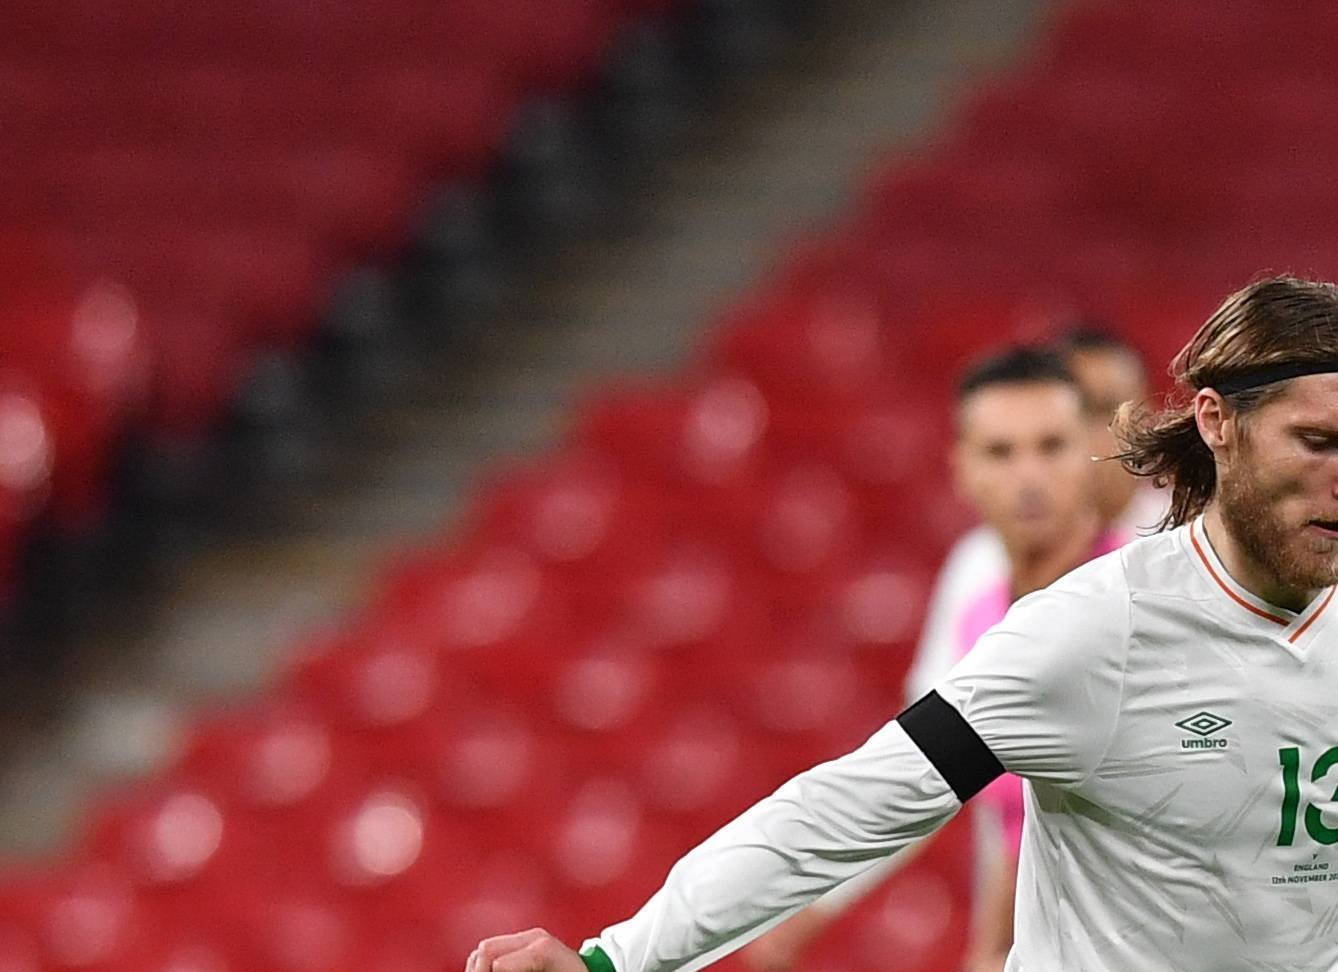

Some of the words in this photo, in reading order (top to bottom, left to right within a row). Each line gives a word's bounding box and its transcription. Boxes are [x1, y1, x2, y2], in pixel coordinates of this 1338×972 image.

[1181, 737, 1228, 749] umbro
[1294, 863, 1329, 872] ENGLAND
[1288, 873, 1327, 884] NOVEMBER
